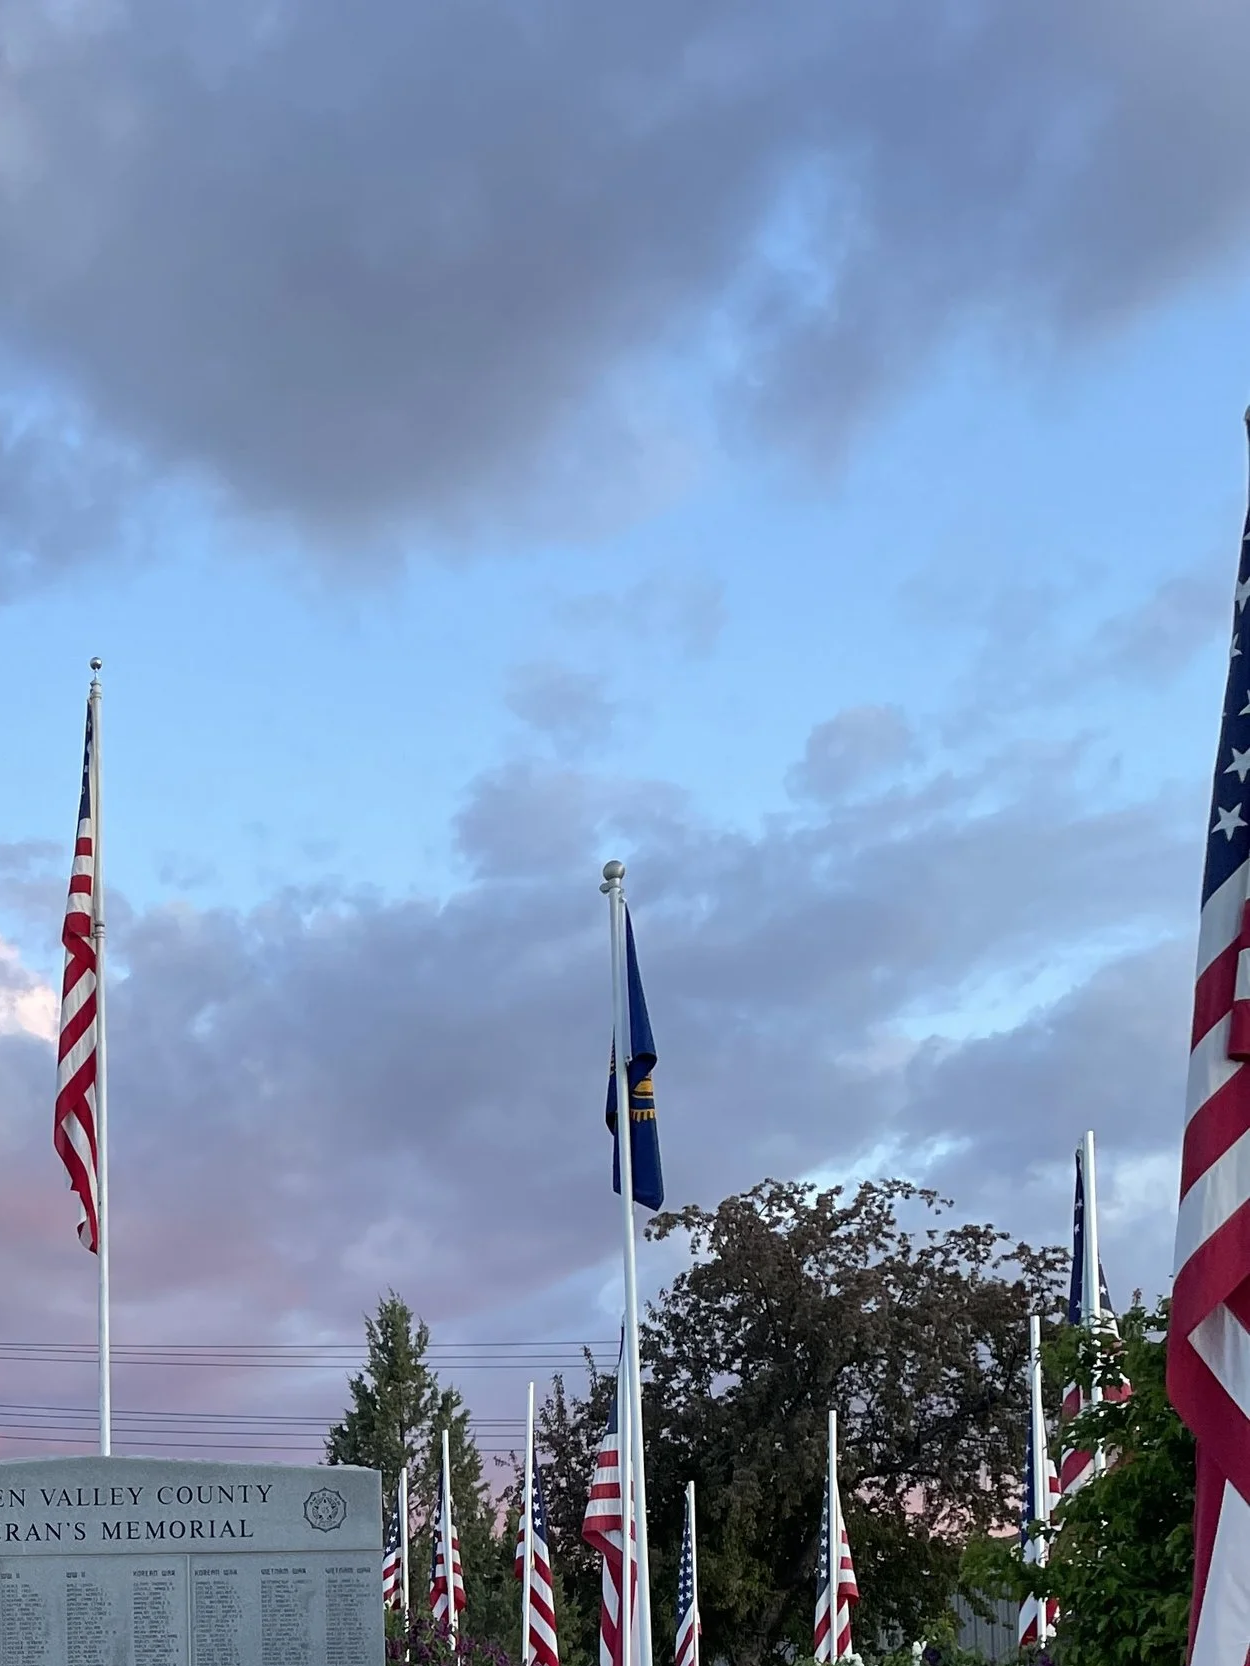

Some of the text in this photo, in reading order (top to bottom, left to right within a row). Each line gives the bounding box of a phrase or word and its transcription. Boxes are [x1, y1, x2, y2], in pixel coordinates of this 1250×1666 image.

[40, 1486, 144, 1507] VALLEY
[157, 1484, 273, 1505] COUNTY
[101, 1519, 254, 1540] MEMORIAL
